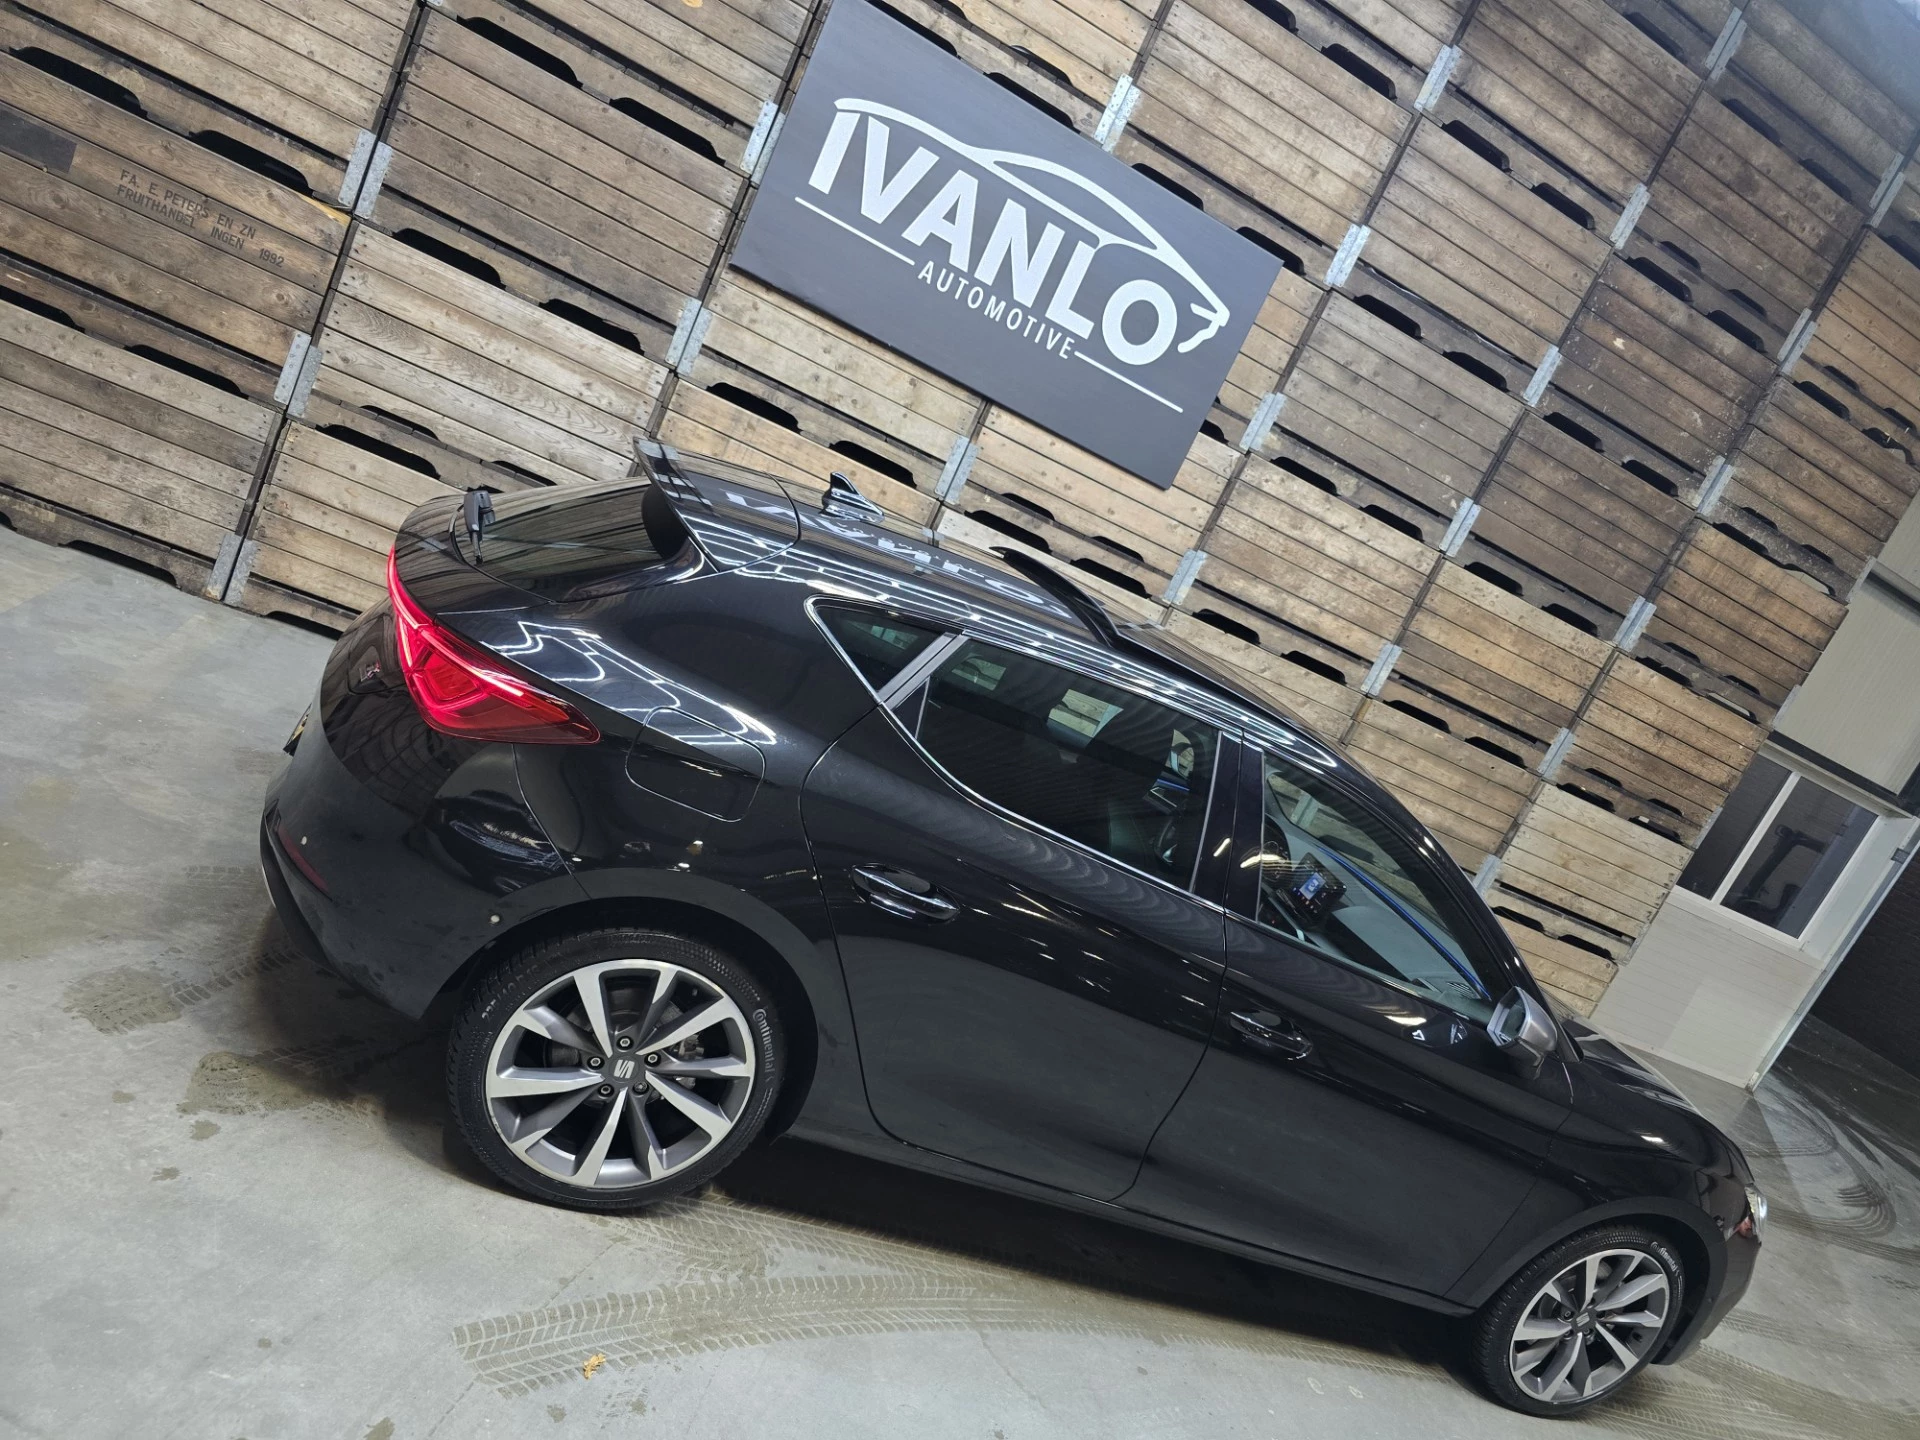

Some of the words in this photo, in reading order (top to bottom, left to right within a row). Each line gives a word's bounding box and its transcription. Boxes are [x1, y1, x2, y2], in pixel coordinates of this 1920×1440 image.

[117, 184, 196, 229] FRUITHANDEL
[210, 226, 245, 250] INGEN
[259, 248, 285, 267] 1992
[164, 189, 209, 218] PETERS
[217, 213, 233, 230] EN
[239, 223, 256, 239] ZN
[808, 110, 1178, 366] IVANLO
[917, 260, 1075, 359] AUTOMOTIVE
[752, 1008, 776, 1072] Continental
